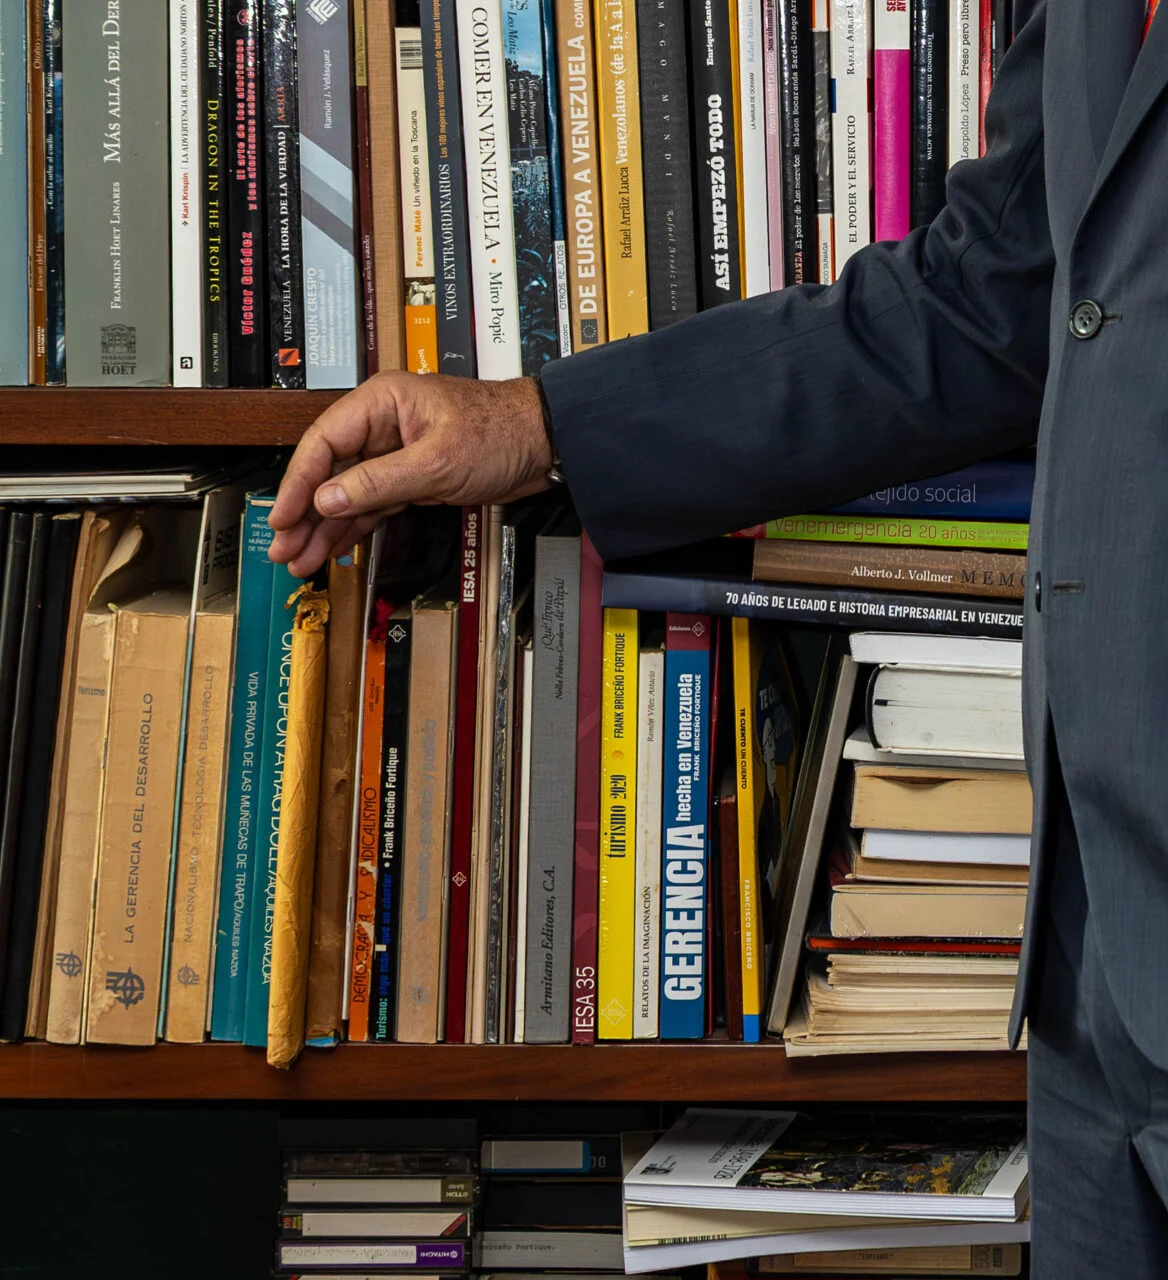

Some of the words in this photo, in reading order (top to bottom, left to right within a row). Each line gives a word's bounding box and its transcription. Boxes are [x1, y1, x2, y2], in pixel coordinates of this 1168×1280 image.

[107, 41, 120, 71] DEL
[472, 7, 489, 84] COMER
[104, 77, 121, 117] ALLÁ
[477, 90, 492, 119] EN
[568, 34, 590, 163] VENEZUELA
[207, 100, 218, 167] DRAGON
[709, 94, 723, 152] TODO
[847, 115, 856, 165] SERVICIO
[103, 122, 121, 162] MÁS
[208, 175, 218, 191] IN
[479, 123, 500, 251] VENEZUELA
[576, 168, 591, 183] A
[848, 168, 856, 180] EL
[209, 200, 218, 229] THE
[708, 155, 729, 250] EMPEZÓ
[849, 192, 857, 228] PODER
[575, 189, 595, 278] EUROPA
[849, 231, 857, 242] EL
[209, 236, 220, 302] TROPICS
[712, 253, 730, 290] ASÍ
[488, 272, 503, 303] Miro
[579, 284, 598, 313] DE
[490, 308, 505, 344] Popić
[925, 484, 976, 503] social
[465, 513, 477, 546] años
[465, 550, 475, 567] 25
[851, 566, 892, 578] Alberto
[895, 569, 904, 579] J.
[909, 570, 952, 583] Vollmer
[463, 571, 475, 602] IESA
[726, 592, 738, 604] 70
[741, 594, 769, 607] AÑOS
[772, 596, 785, 607] DE
[788, 598, 826, 611] LEGADO
[830, 601, 836, 611] E
[839, 601, 885, 615] HISTORIA
[888, 605, 958, 621] EMPRESARIAL
[961, 611, 975, 622] EN
[614, 633, 625, 672] FORTIQUE
[613, 675, 625, 710] BRICEÑO
[614, 712, 624, 738] FRANK
[677, 674, 693, 749] Venezuela
[135, 693, 153, 796] DESARROLLO
[679, 753, 691, 771] en
[676, 777, 691, 821] hecha
[132, 804, 144, 833] DEL
[126, 841, 141, 917] GERENCIA
[665, 824, 705, 1000] GERENCIA
[124, 925, 134, 943] LA
[576, 967, 594, 989] 35
[576, 994, 594, 1032] IESA
